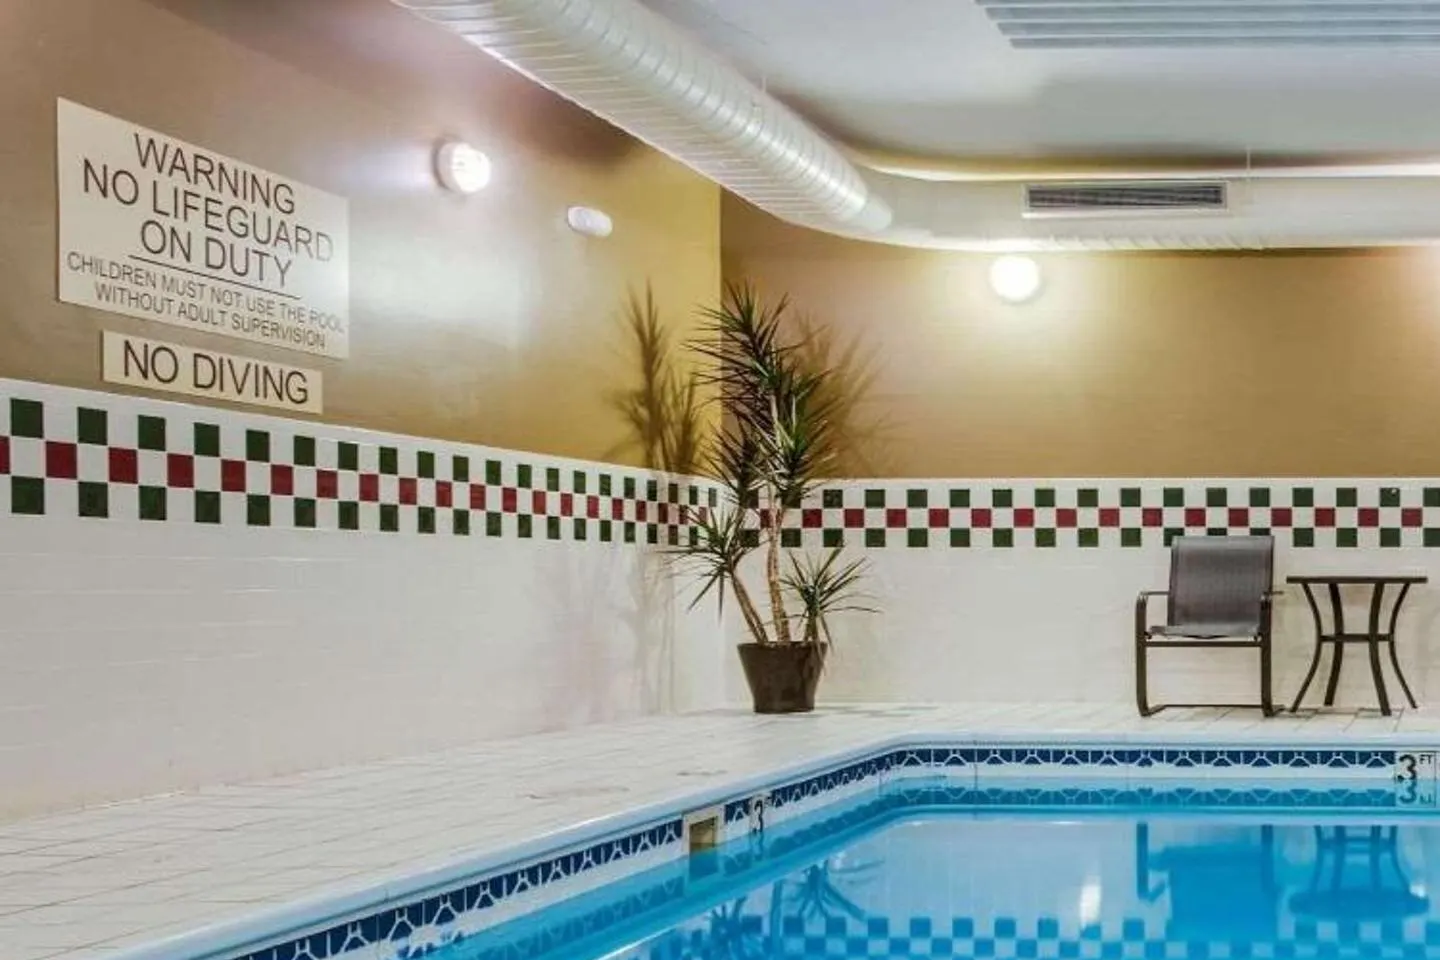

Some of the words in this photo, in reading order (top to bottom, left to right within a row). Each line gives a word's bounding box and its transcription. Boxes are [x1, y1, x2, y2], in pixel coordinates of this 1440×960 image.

[134, 132, 295, 214] WARNING
[84, 157, 139, 205] NO
[153, 180, 333, 262] LIFEGUARD
[141, 219, 191, 262] ON
[205, 236, 292, 287] DUTY
[67, 251, 157, 289] CHILDREN
[161, 273, 207, 300] MUST
[211, 285, 243, 308] NOT
[246, 296, 275, 317] USE
[279, 302, 305, 324] THE
[308, 306, 345, 334] POOL
[94, 280, 175, 315] WITHOUT
[178, 301, 226, 327] ADULT
[231, 312, 326, 349] SUPERVISION
[124, 339, 178, 384] NO
[193, 352, 309, 404] DIVING
[1397, 753, 1417, 781] 3
